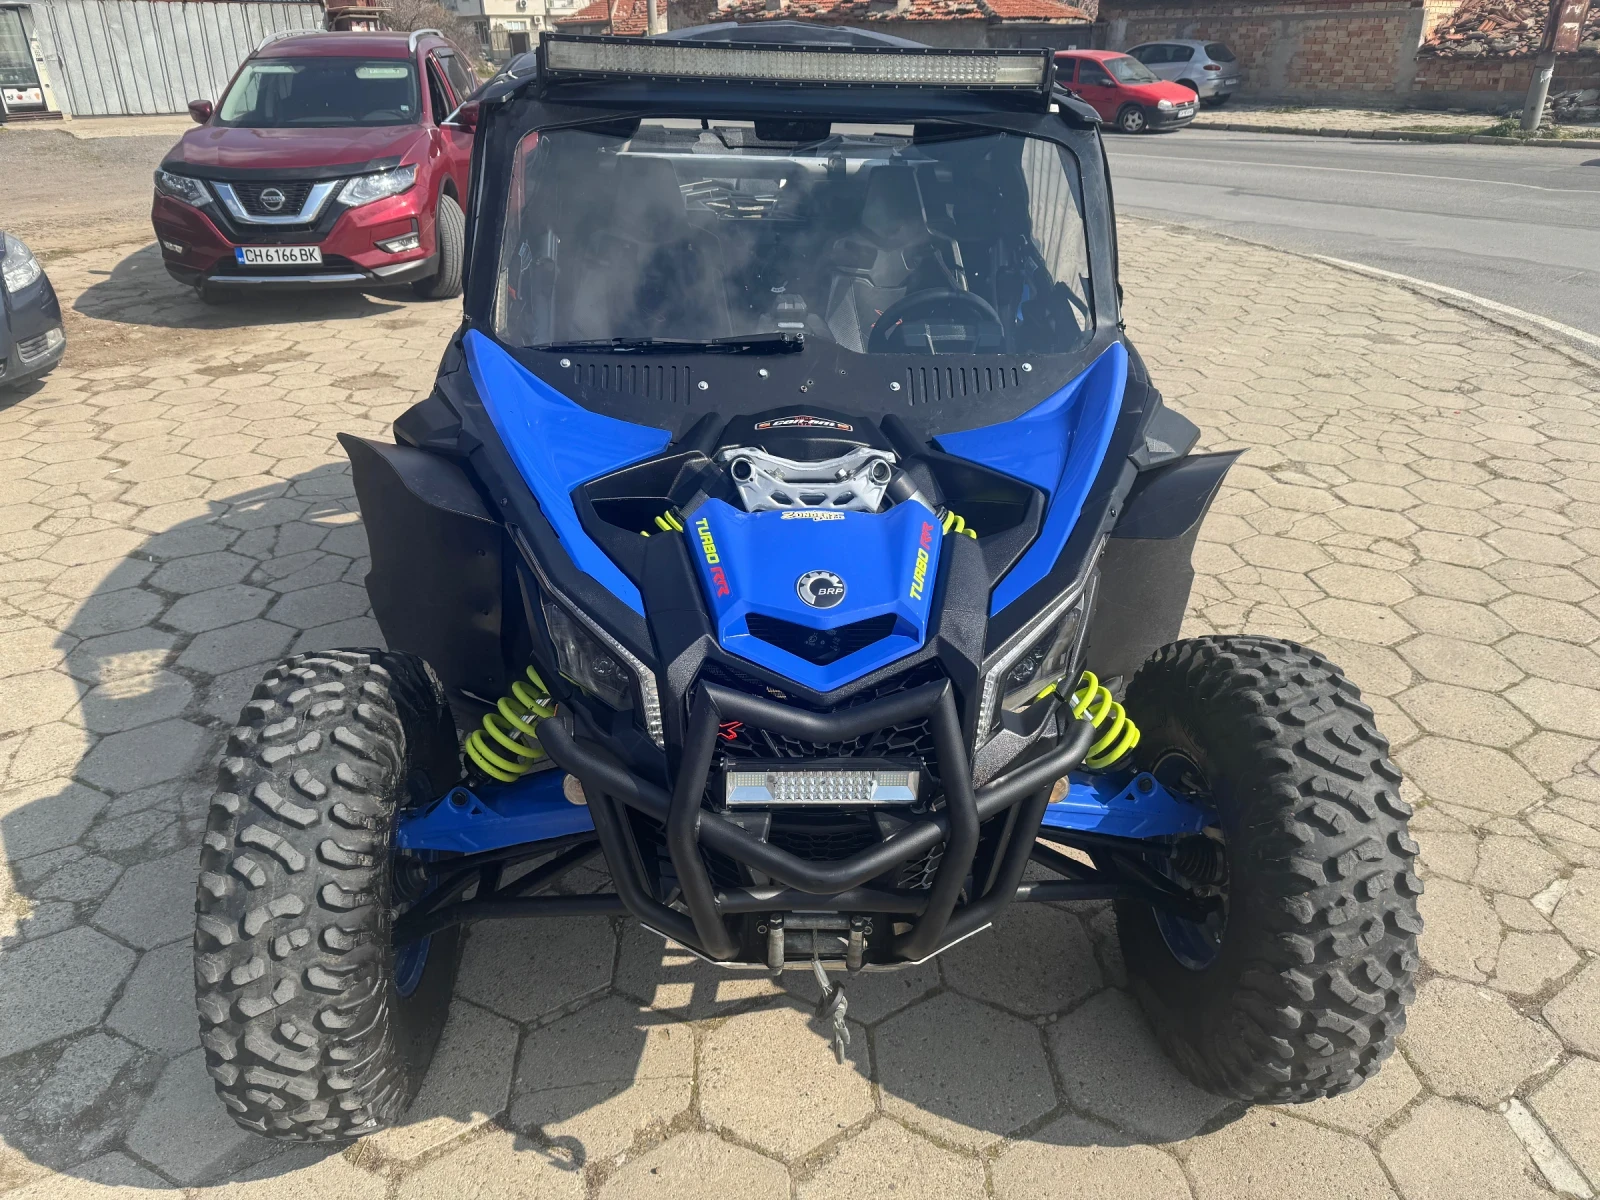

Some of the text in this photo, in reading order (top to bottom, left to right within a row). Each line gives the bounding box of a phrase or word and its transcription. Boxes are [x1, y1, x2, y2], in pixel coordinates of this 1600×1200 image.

[245, 247, 318, 262] CH 6166 BK
[695, 517, 730, 598] TURBO RR
[909, 521, 934, 600] TURBO RR
[818, 587, 844, 596] BRP
